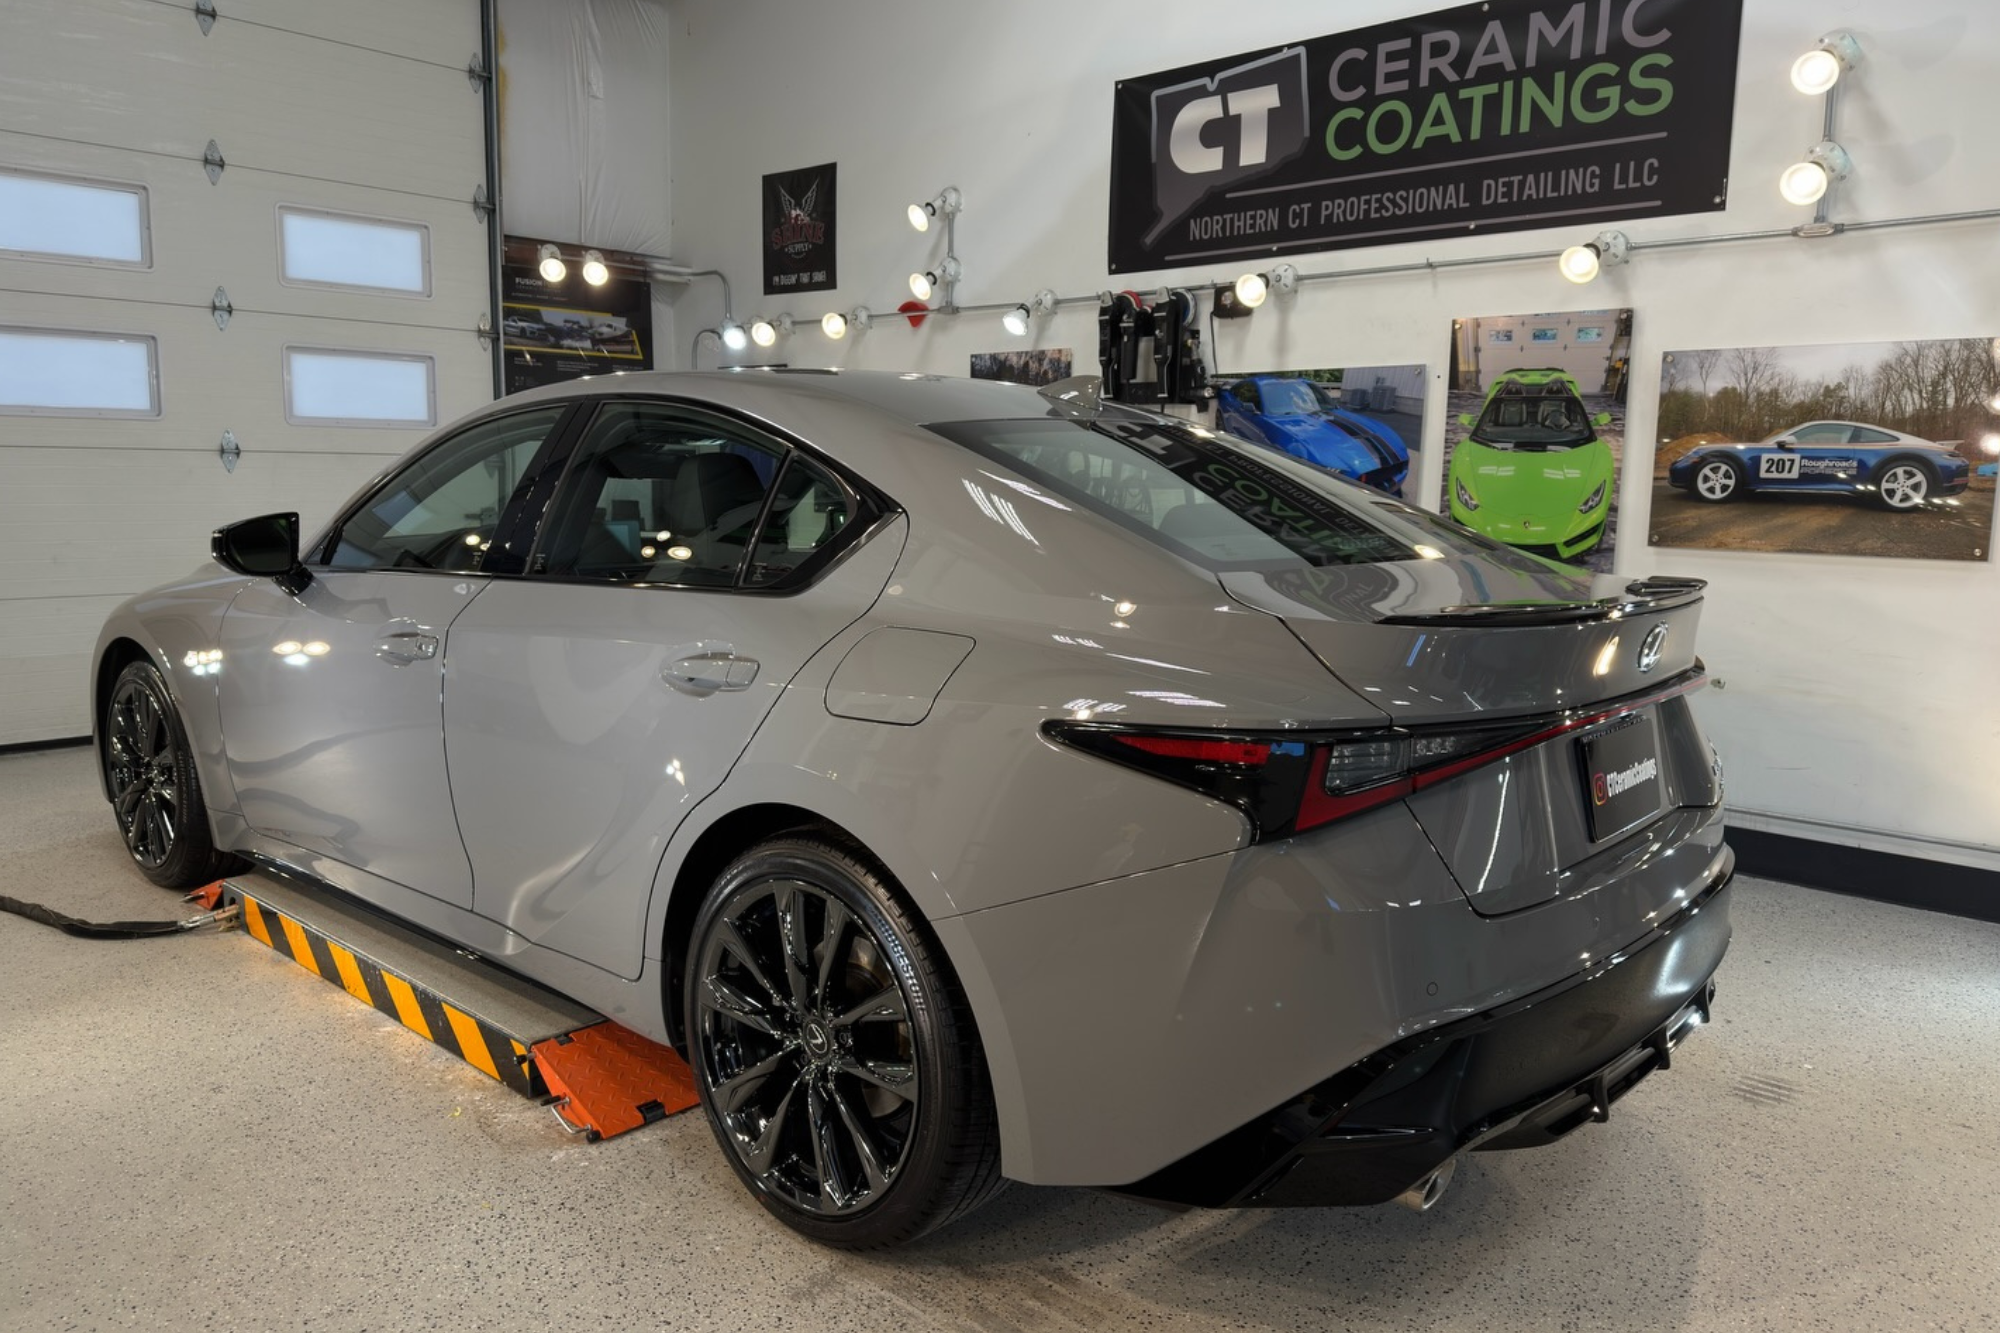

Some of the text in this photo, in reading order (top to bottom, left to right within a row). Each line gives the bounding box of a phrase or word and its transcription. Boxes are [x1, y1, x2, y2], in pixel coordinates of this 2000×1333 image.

[1327, 0, 1672, 102] CERAMIC
[1169, 84, 1280, 174] CT
[1325, 52, 1674, 161] COATINGS
[1189, 157, 1659, 241] NORTHERN CT PROFESSIONAL DETAILING LLC
[515, 277, 543, 286] FUSION
[1765, 458, 1796, 474] 207
[1801, 458, 1857, 468] Roughroads
